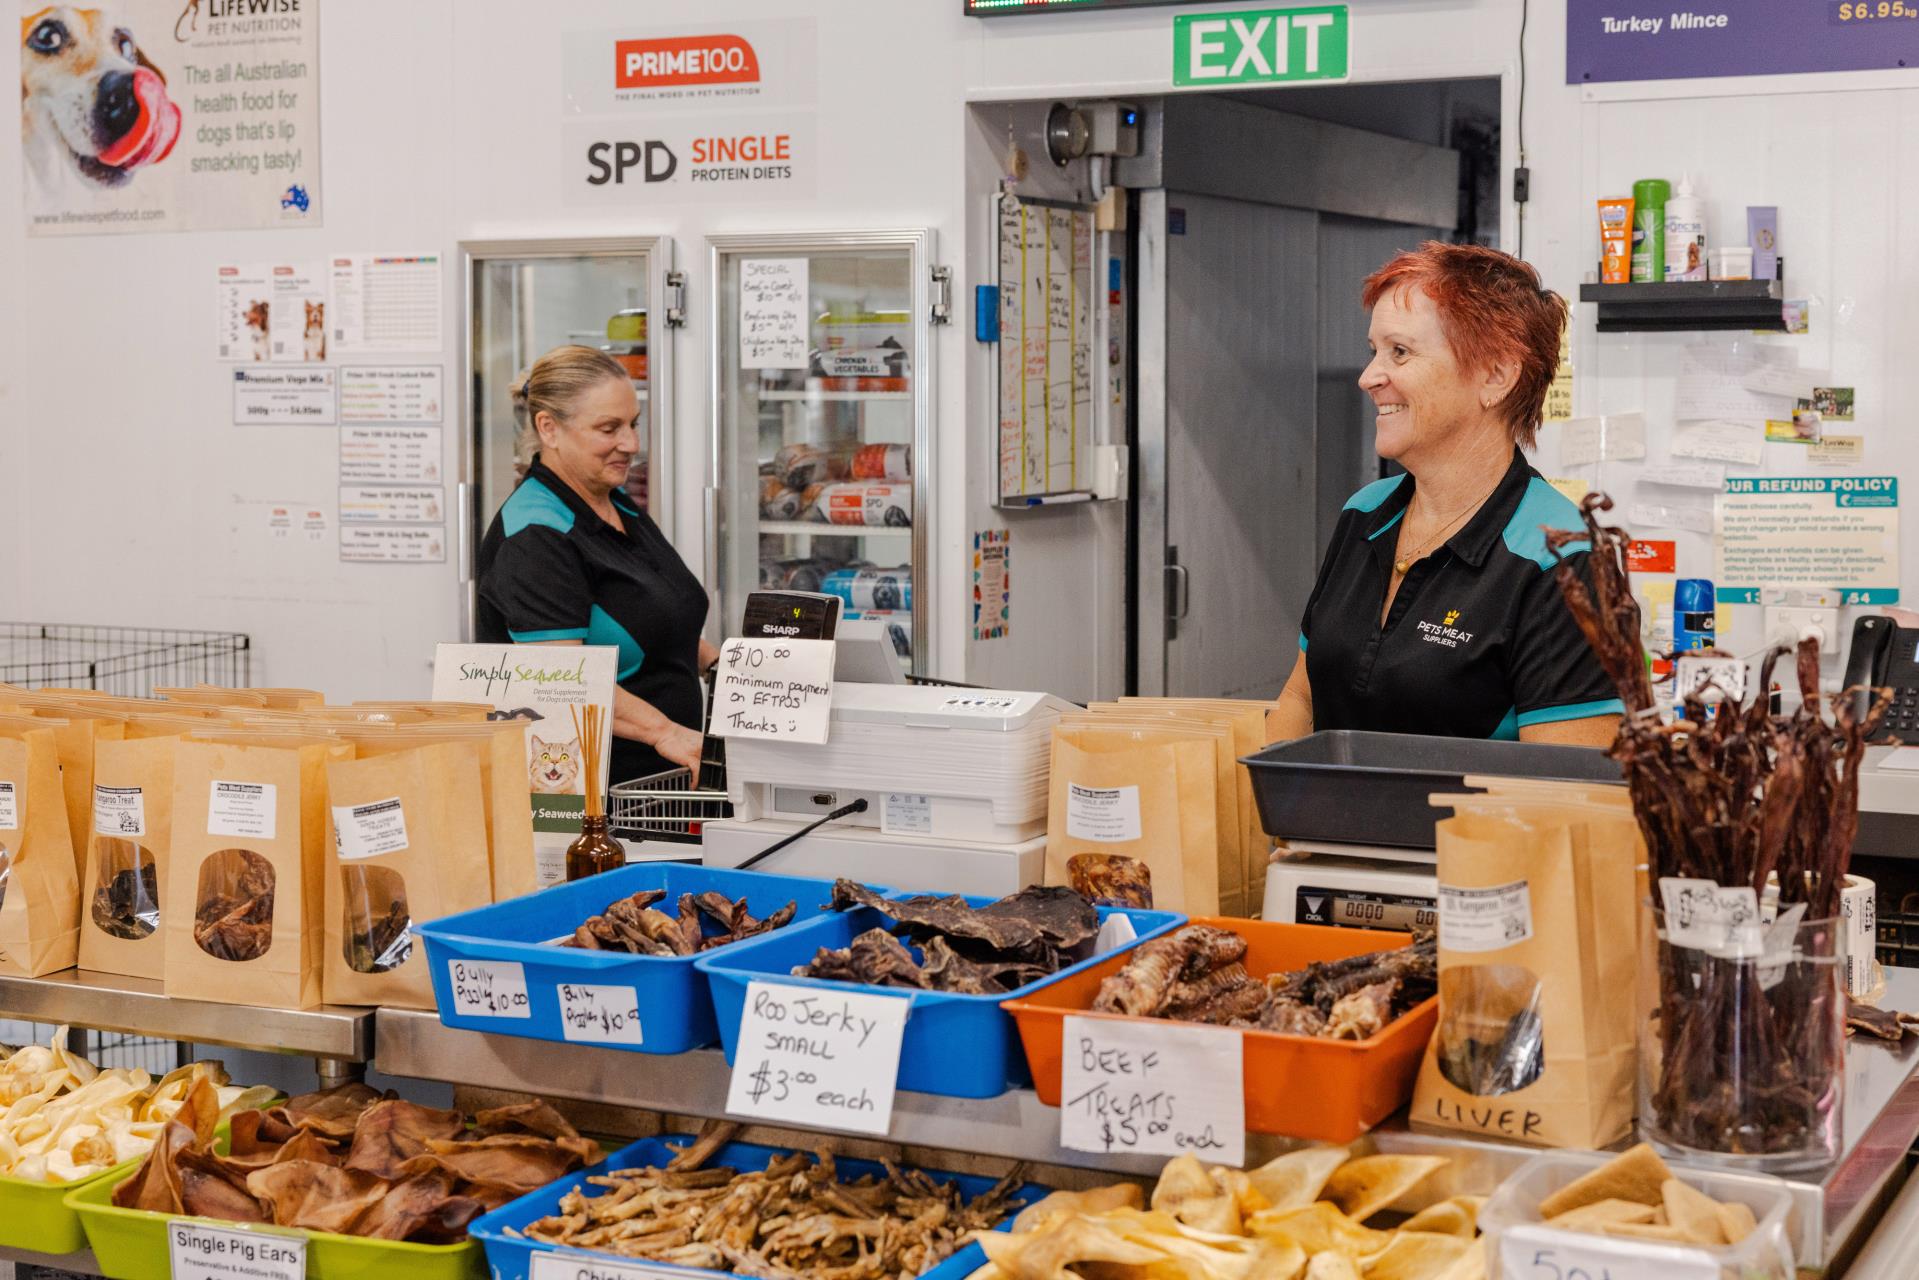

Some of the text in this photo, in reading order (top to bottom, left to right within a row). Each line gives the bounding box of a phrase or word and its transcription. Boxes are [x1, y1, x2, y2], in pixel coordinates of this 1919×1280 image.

[207, 17, 302, 36] PET NUTRITION
[1601, 12, 1729, 34] Turkey Mince
[1189, 13, 1334, 79] EXIT
[184, 60, 307, 85] The all Australian
[194, 89, 298, 113] health food for
[715, 88, 760, 96] NUTRITION
[196, 121, 296, 146] dogs that's lip
[691, 135, 791, 164] SINGLE
[191, 149, 303, 175] smacking tasty!
[586, 140, 678, 186] SPD
[691, 166, 792, 182] PROTEIN DIETS
[1759, 479, 1826, 492] REFUND
[1831, 478, 1893, 491] POLICY
[1750, 525, 1778, 533] change
[1830, 524, 1851, 532] make
[1860, 525, 1885, 533] wrong
[1724, 547, 1765, 555] Exchanges
[793, 607, 801, 618] 4
[762, 624, 800, 635] SHARP
[1417, 620, 1474, 643] PETS MEAT
[1422, 634, 1458, 648] SUPPLIERS
[459, 652, 587, 699] Simply Seaweed
[533, 688, 588, 698] Dental Supplement
[726, 673, 829, 703] minimum payment
[546, 696, 562, 704] Dogs
[572, 696, 587, 704] Cats
[730, 691, 801, 709] on EFTPOS
[727, 711, 778, 733] Thanks
[118, 795, 135, 804] Treat
[538, 807, 585, 820] Seaweed
[793, 997, 876, 1048] Jerky
[1081, 1037, 1159, 1077] BEEF
[815, 1088, 874, 1111] each
[1068, 1081, 1176, 1120] TREATS
[1436, 1098, 1544, 1137] LIVER
[1175, 1125, 1225, 1149] each
[177, 1231, 297, 1264] Single Pig Ears
[184, 1257, 230, 1271] Preservative
[239, 1267, 269, 1278] Additive
